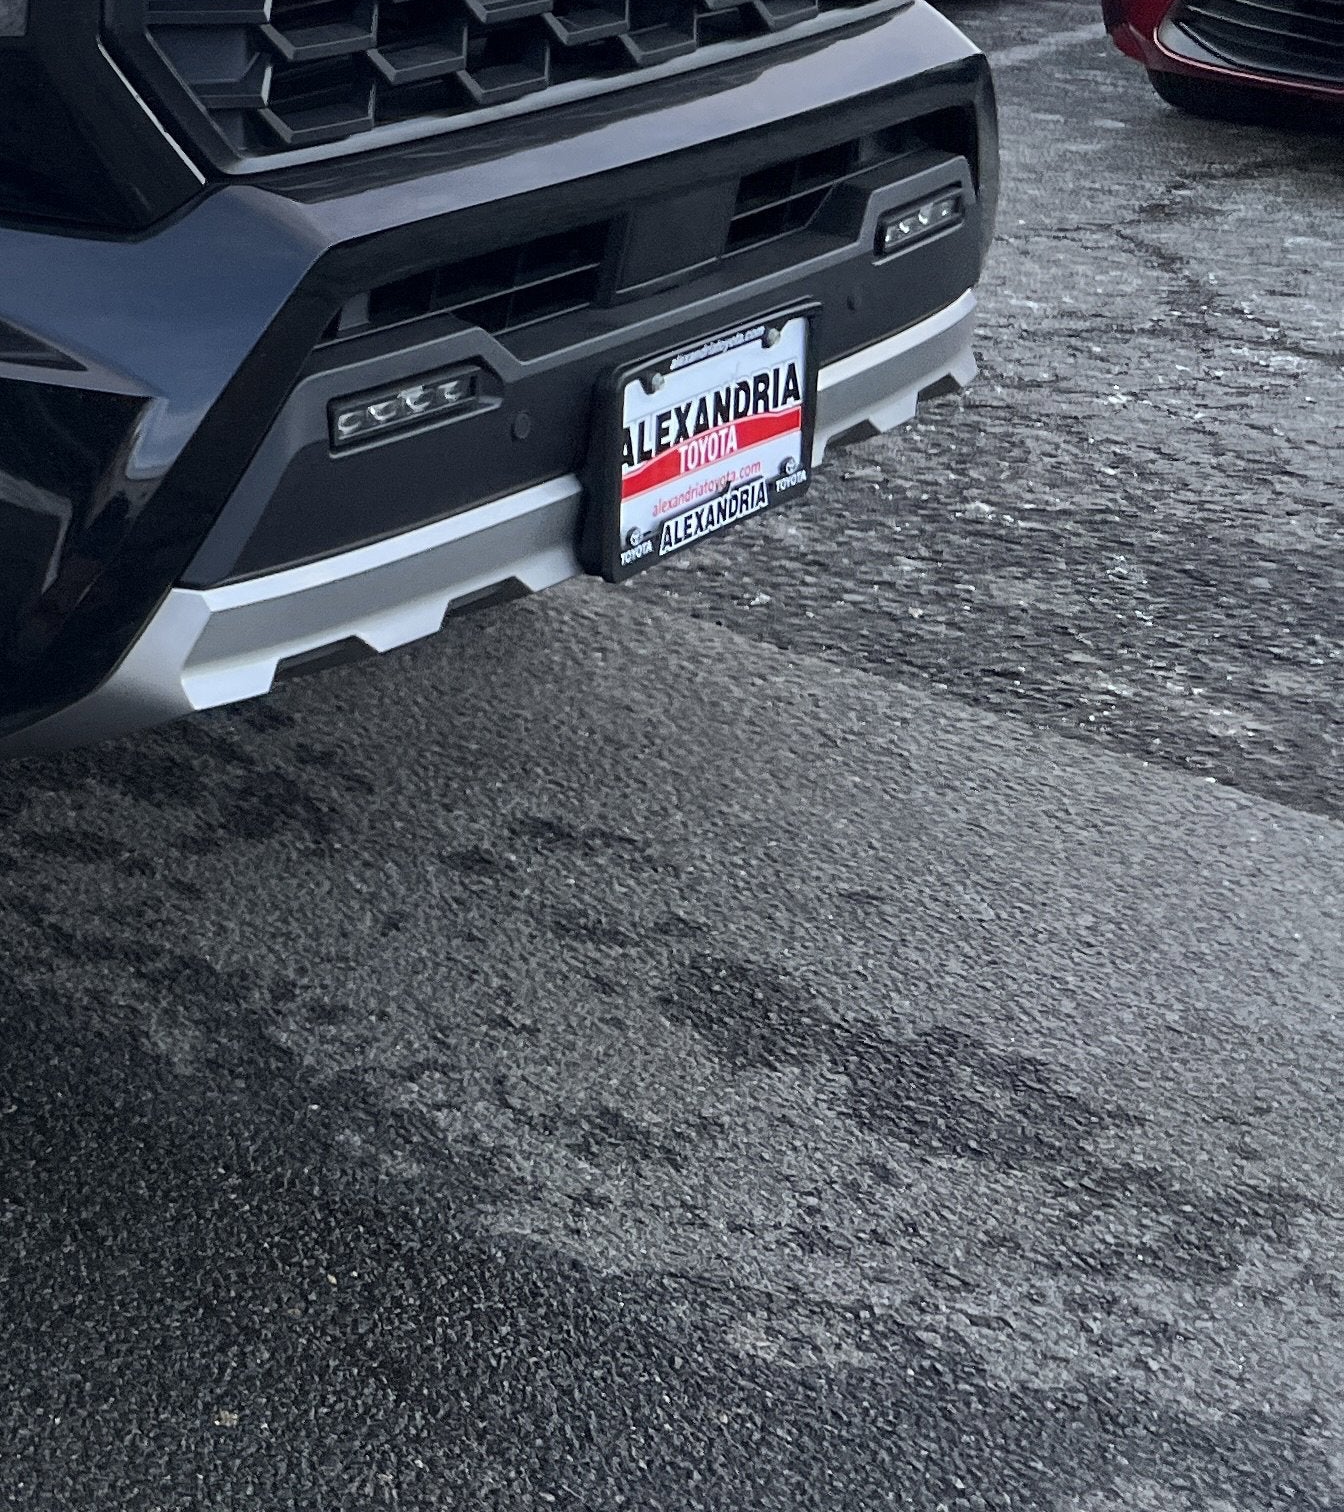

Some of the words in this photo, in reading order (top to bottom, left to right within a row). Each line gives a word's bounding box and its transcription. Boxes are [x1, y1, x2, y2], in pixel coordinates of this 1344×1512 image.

[622, 363, 800, 466] ALEXANDRIA
[678, 426, 738, 473] TOYOTA
[652, 461, 761, 517] alexandriatoyota.com
[775, 470, 807, 493] TOYOTA
[661, 479, 768, 554] ALEXANDRIA
[620, 540, 653, 565] TOYOTA
